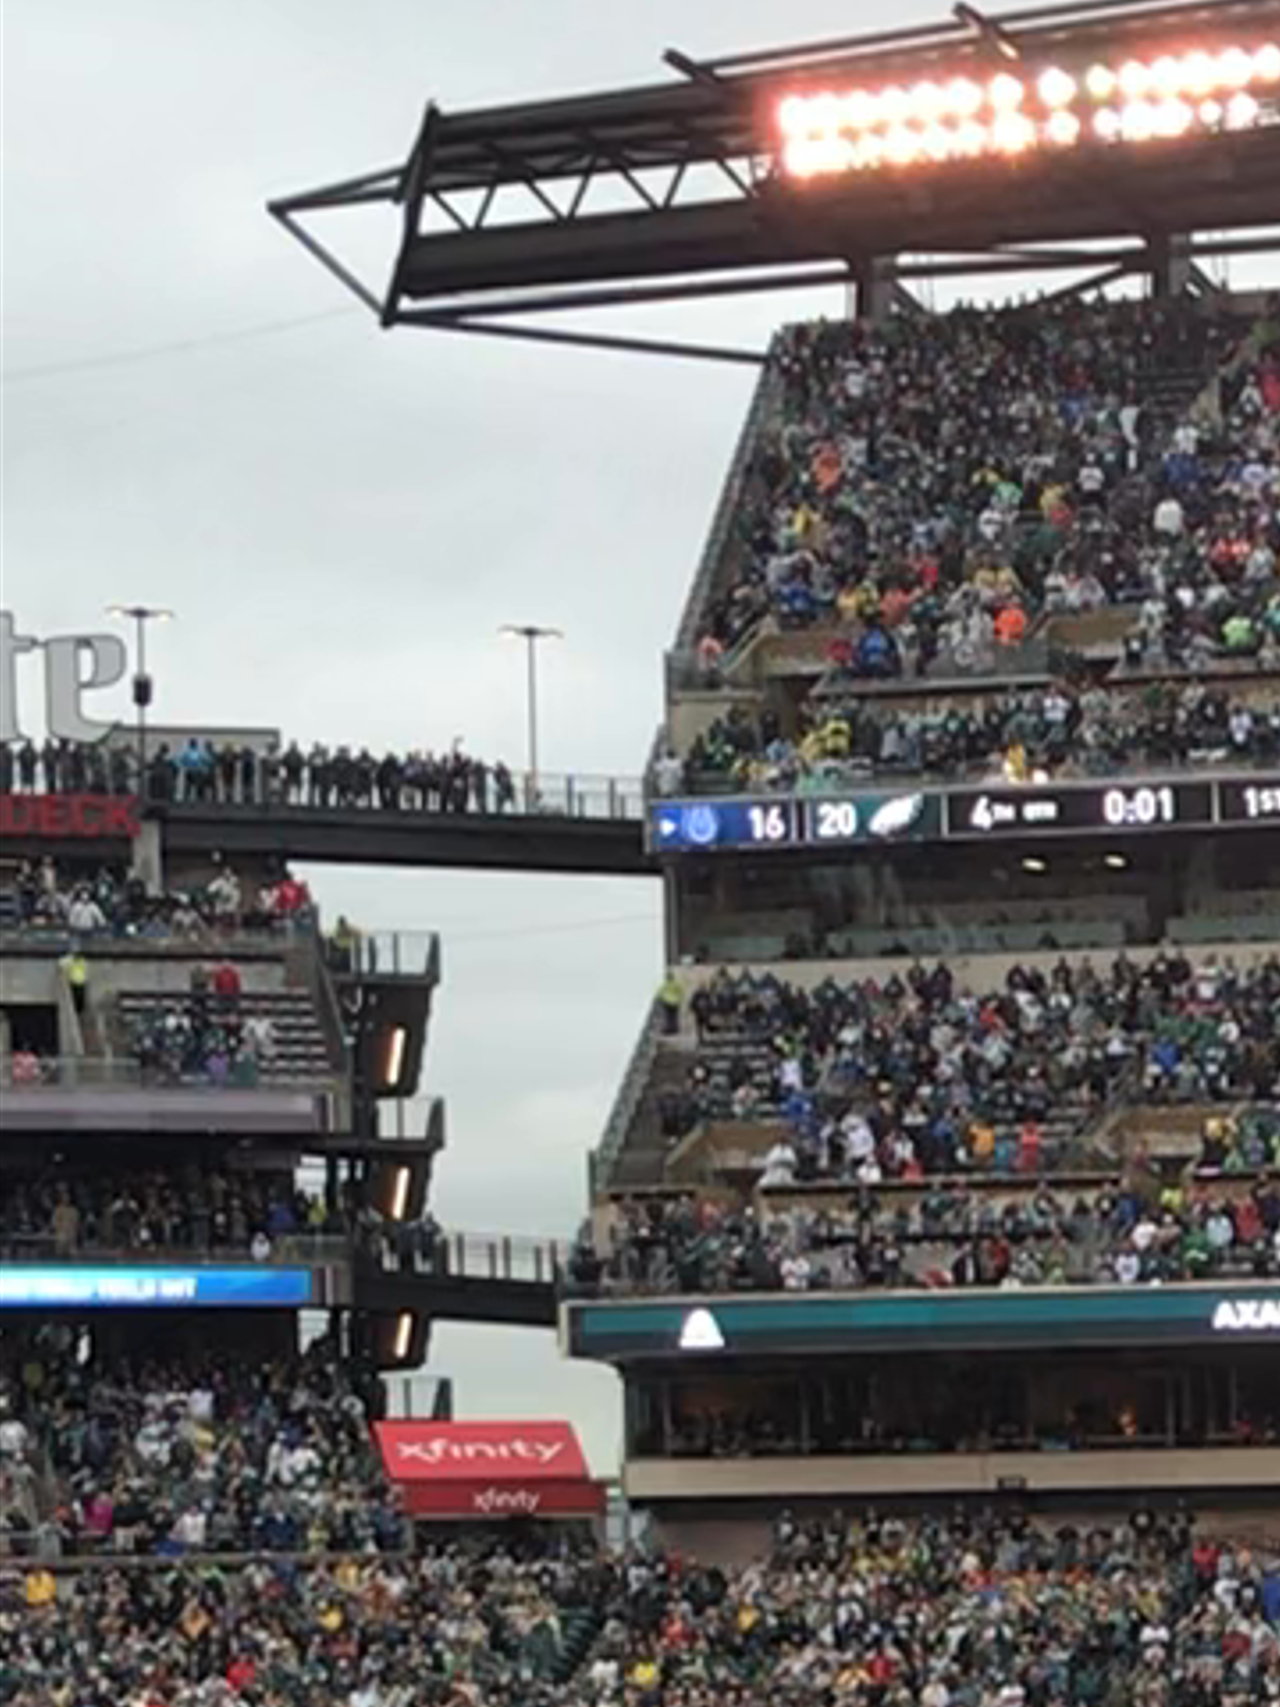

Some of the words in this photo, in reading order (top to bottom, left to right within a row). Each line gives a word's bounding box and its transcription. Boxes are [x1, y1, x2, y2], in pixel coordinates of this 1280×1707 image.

[748, 804, 785, 840] 16
[817, 803, 857, 836] 20
[1104, 787, 1174, 824] 0:01
[396, 1437, 565, 1464] xfinity
[473, 1486, 541, 1512] xfinity
